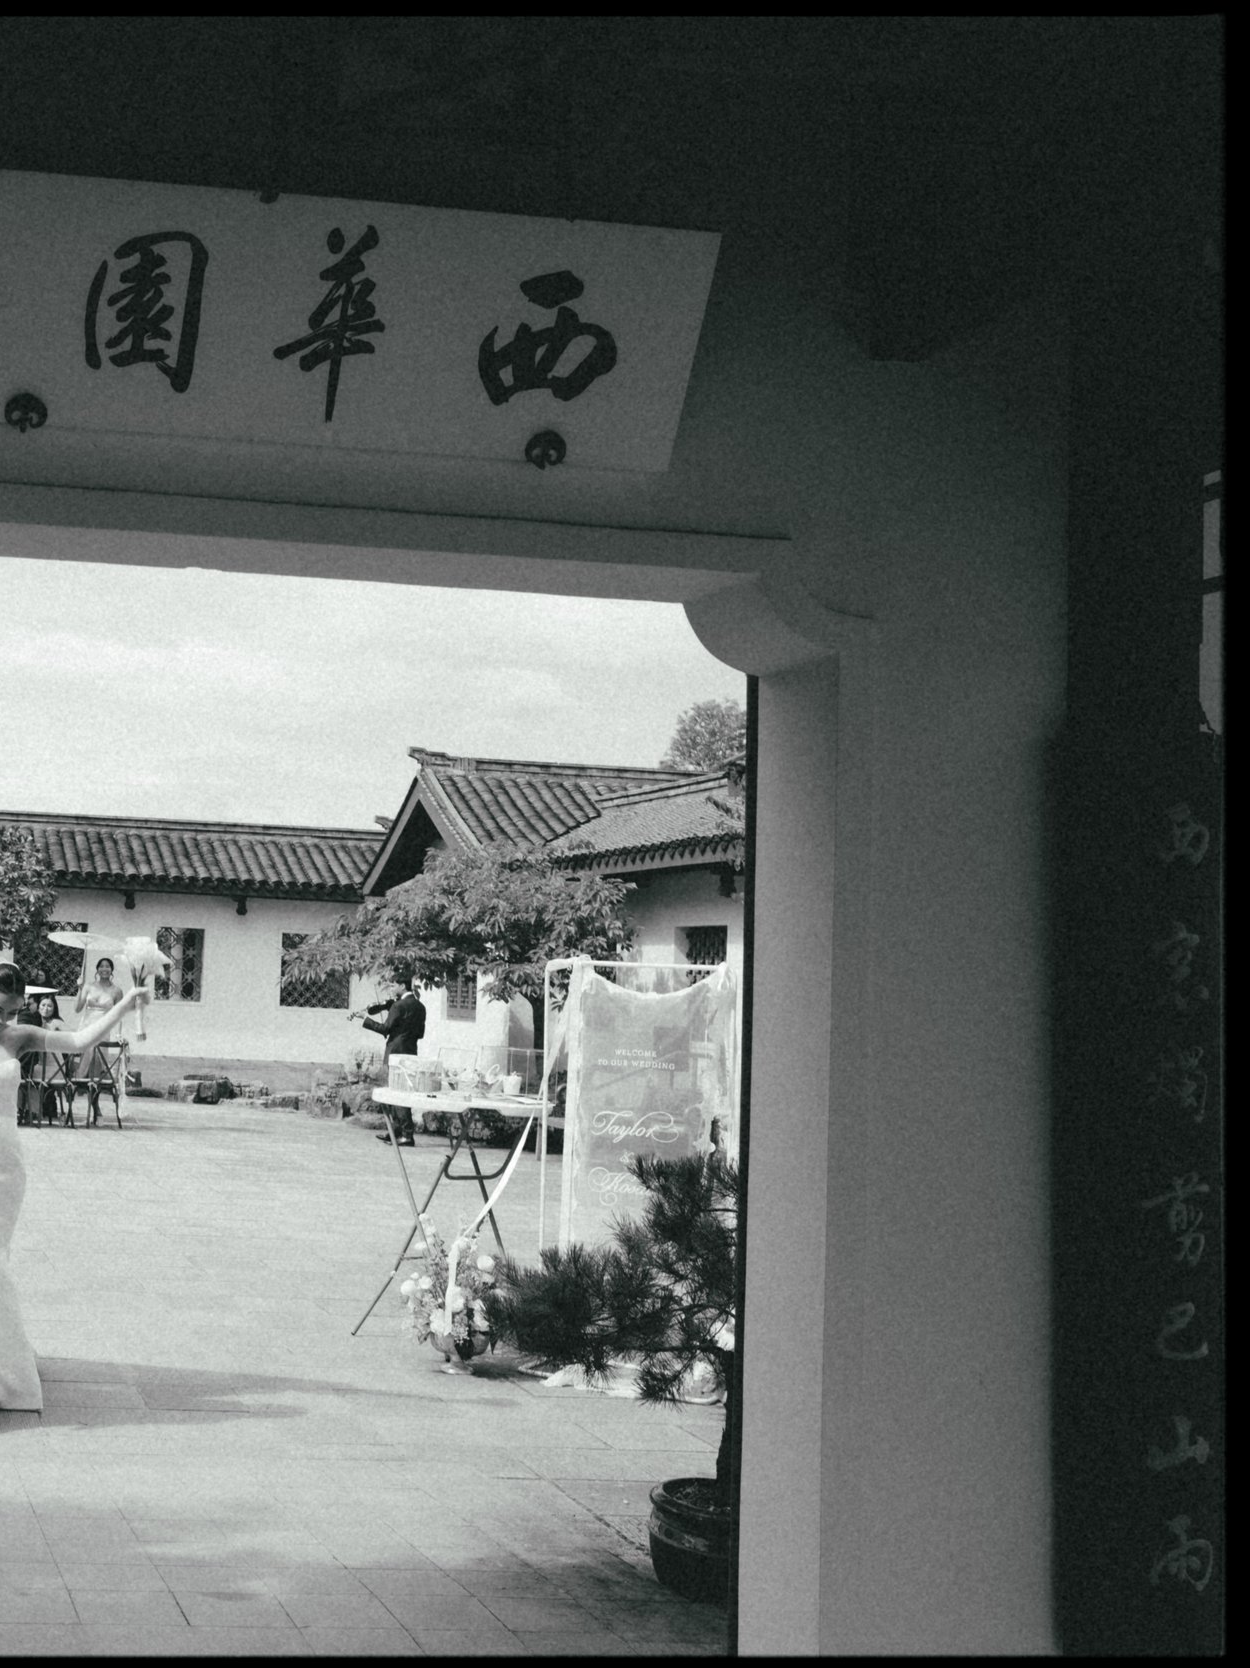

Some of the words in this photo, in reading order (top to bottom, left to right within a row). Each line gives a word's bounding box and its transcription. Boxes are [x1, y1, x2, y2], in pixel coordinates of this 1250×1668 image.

[84, 224, 617, 423] 西華園
[598, 1058, 608, 1066] TO
[610, 1059, 628, 1067] OUR
[631, 1060, 676, 1071] WEDDING
[615, 1048, 657, 1058] WELCOME
[591, 1110, 680, 1144] Taylor
[588, 1166, 653, 1206] Kosa
